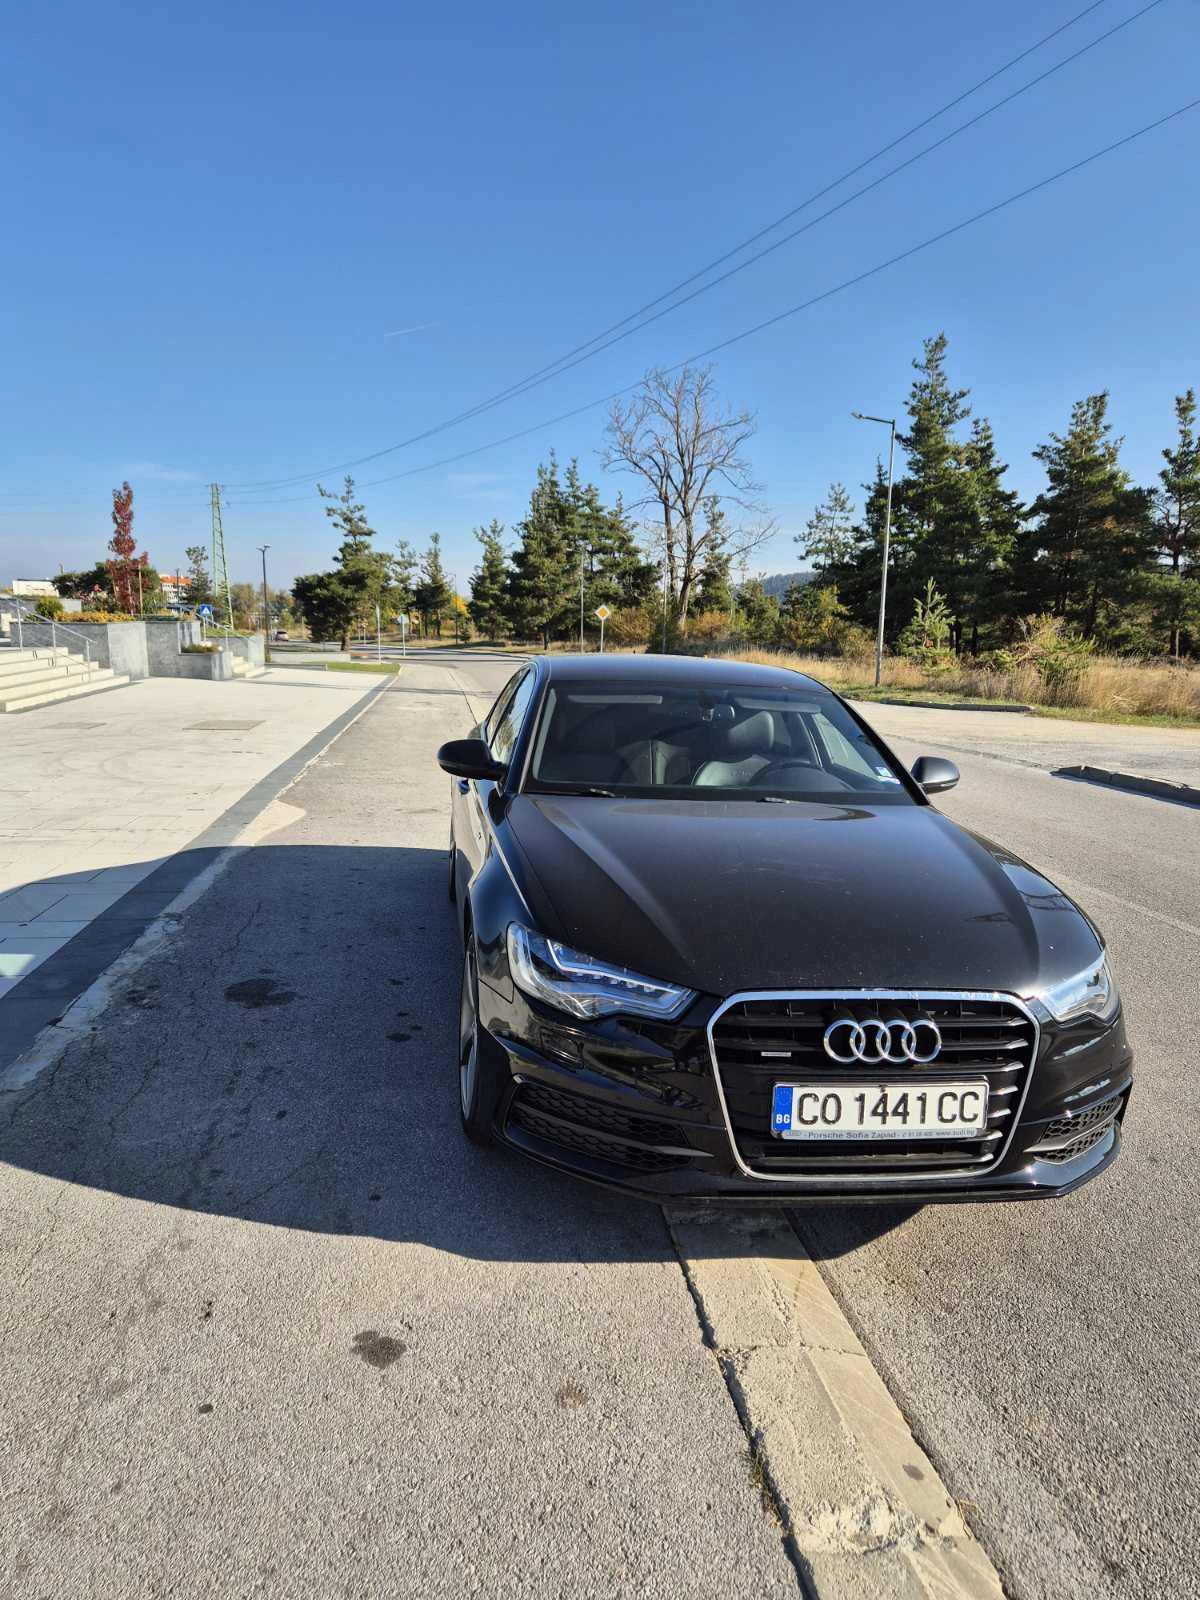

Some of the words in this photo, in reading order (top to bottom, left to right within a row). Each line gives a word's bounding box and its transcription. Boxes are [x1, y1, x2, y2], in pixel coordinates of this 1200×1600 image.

[854, 1092, 926, 1125] 1441
[937, 1091, 980, 1124] CC
[775, 1114, 791, 1124] BG
[808, 1131, 844, 1139] Porsche
[846, 1131, 870, 1139] Sofia
[871, 1130, 896, 1140] Zapad
